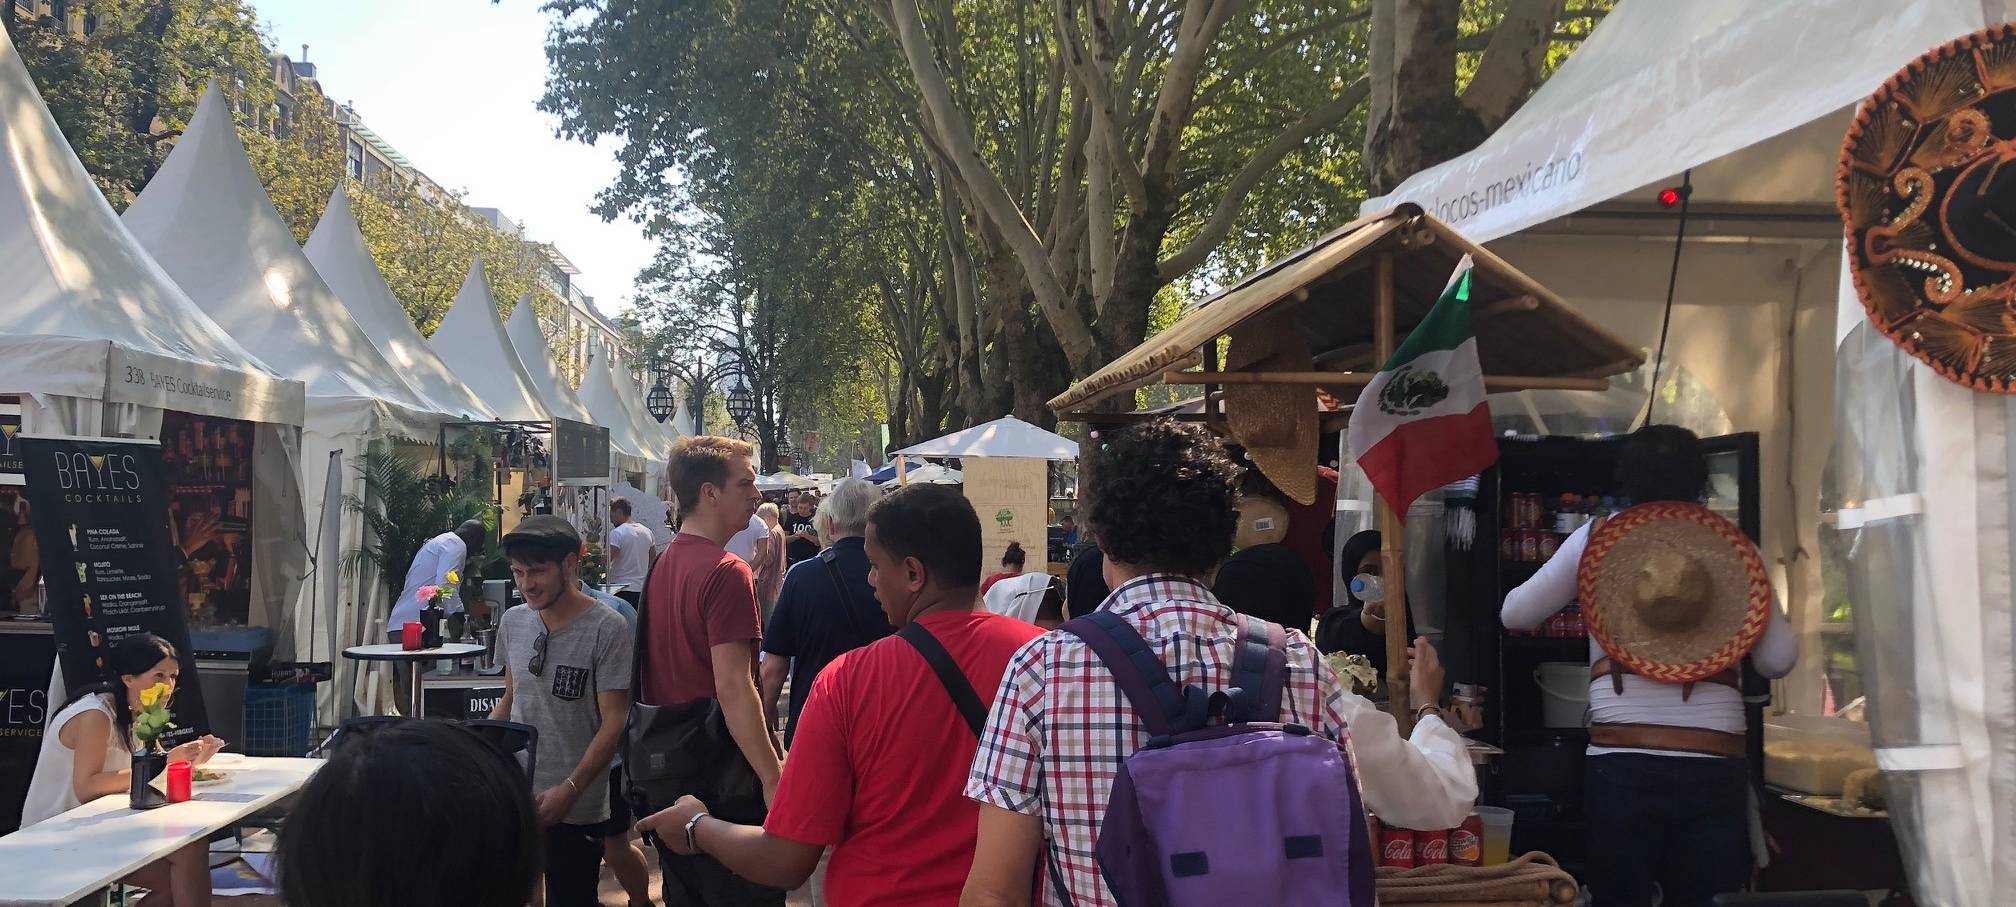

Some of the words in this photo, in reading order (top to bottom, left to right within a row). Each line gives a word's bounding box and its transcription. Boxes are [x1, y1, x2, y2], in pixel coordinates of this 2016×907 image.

[1429, 152, 1582, 224] locos-mexicano
[124, 366, 145, 385] 338
[177, 379, 232, 402] Cocktailservice
[54, 451, 140, 490] BAYES
[65, 494, 142, 503] COCKTAILS
[1384, 839, 1412, 860] Cola
